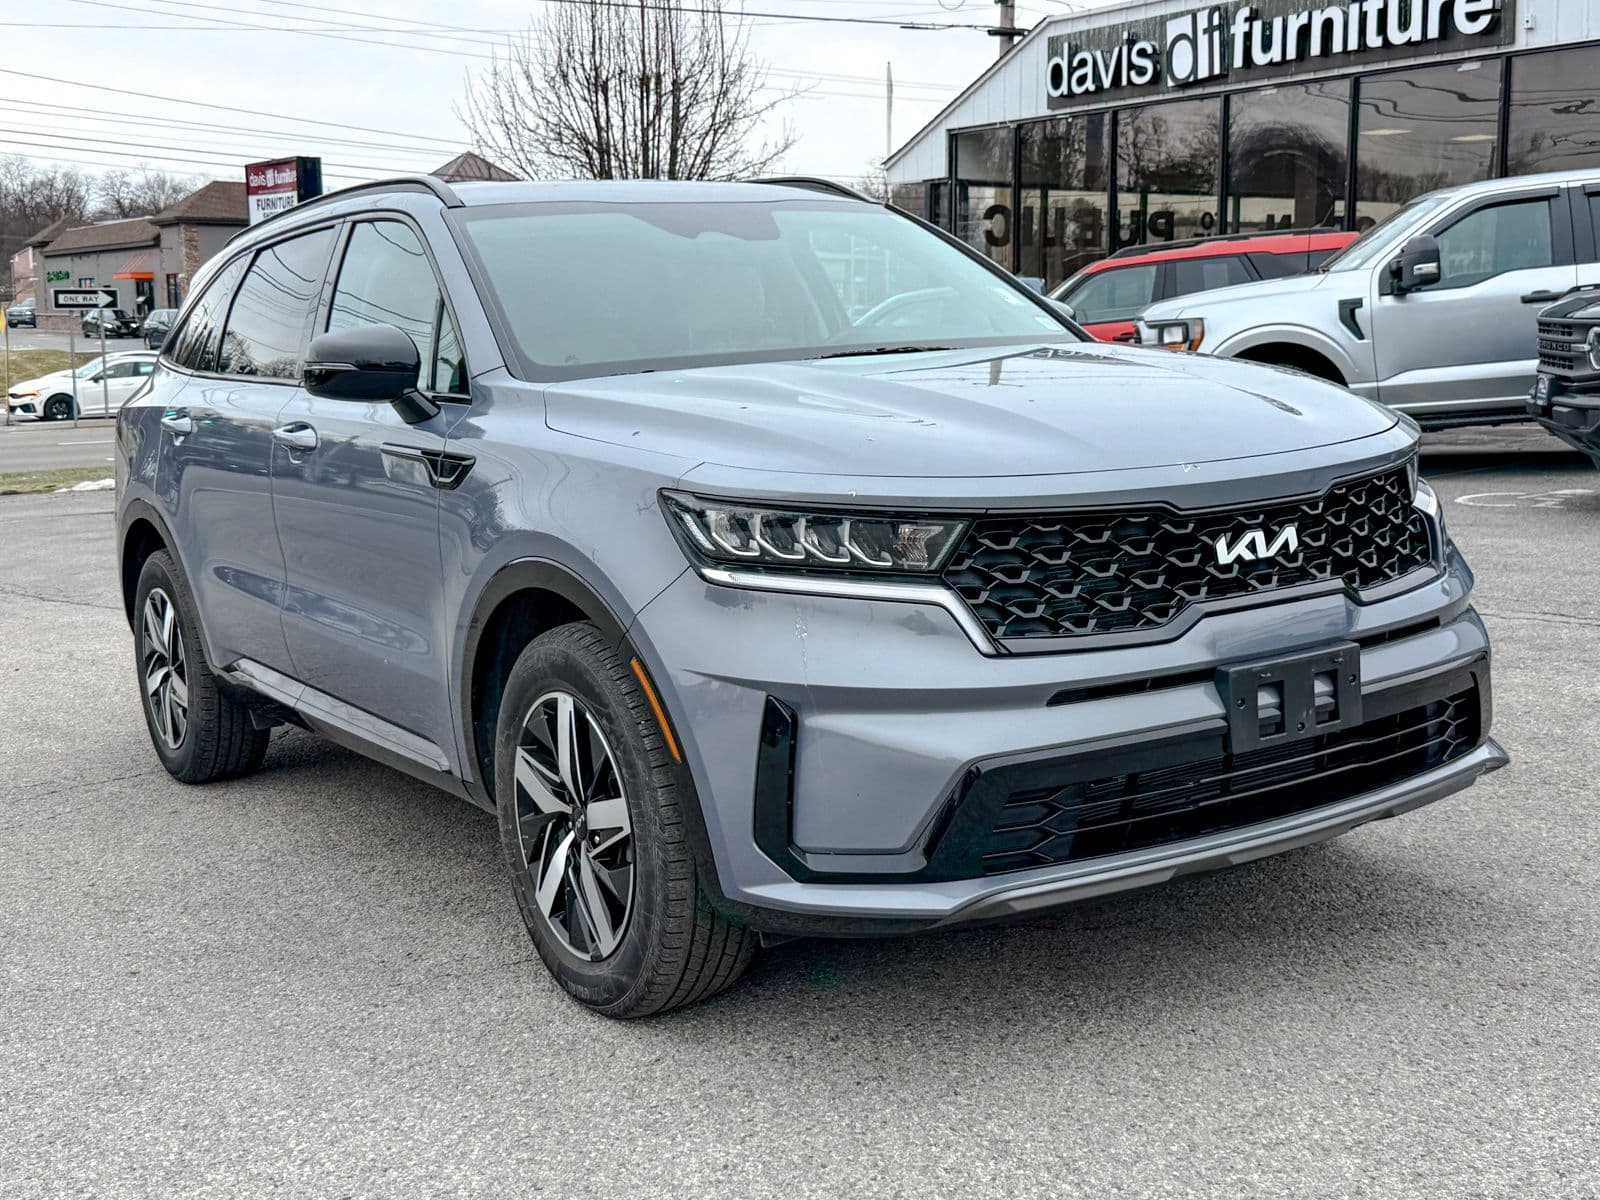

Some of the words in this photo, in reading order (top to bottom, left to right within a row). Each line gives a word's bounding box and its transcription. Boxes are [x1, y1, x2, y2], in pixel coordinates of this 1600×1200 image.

[1046, 31, 1154, 97] davis
[1231, 0, 1495, 69] furniture
[256, 196, 294, 211] FURNITURE
[63, 295, 80, 303] ONE
[1215, 526, 1298, 565] KIA
